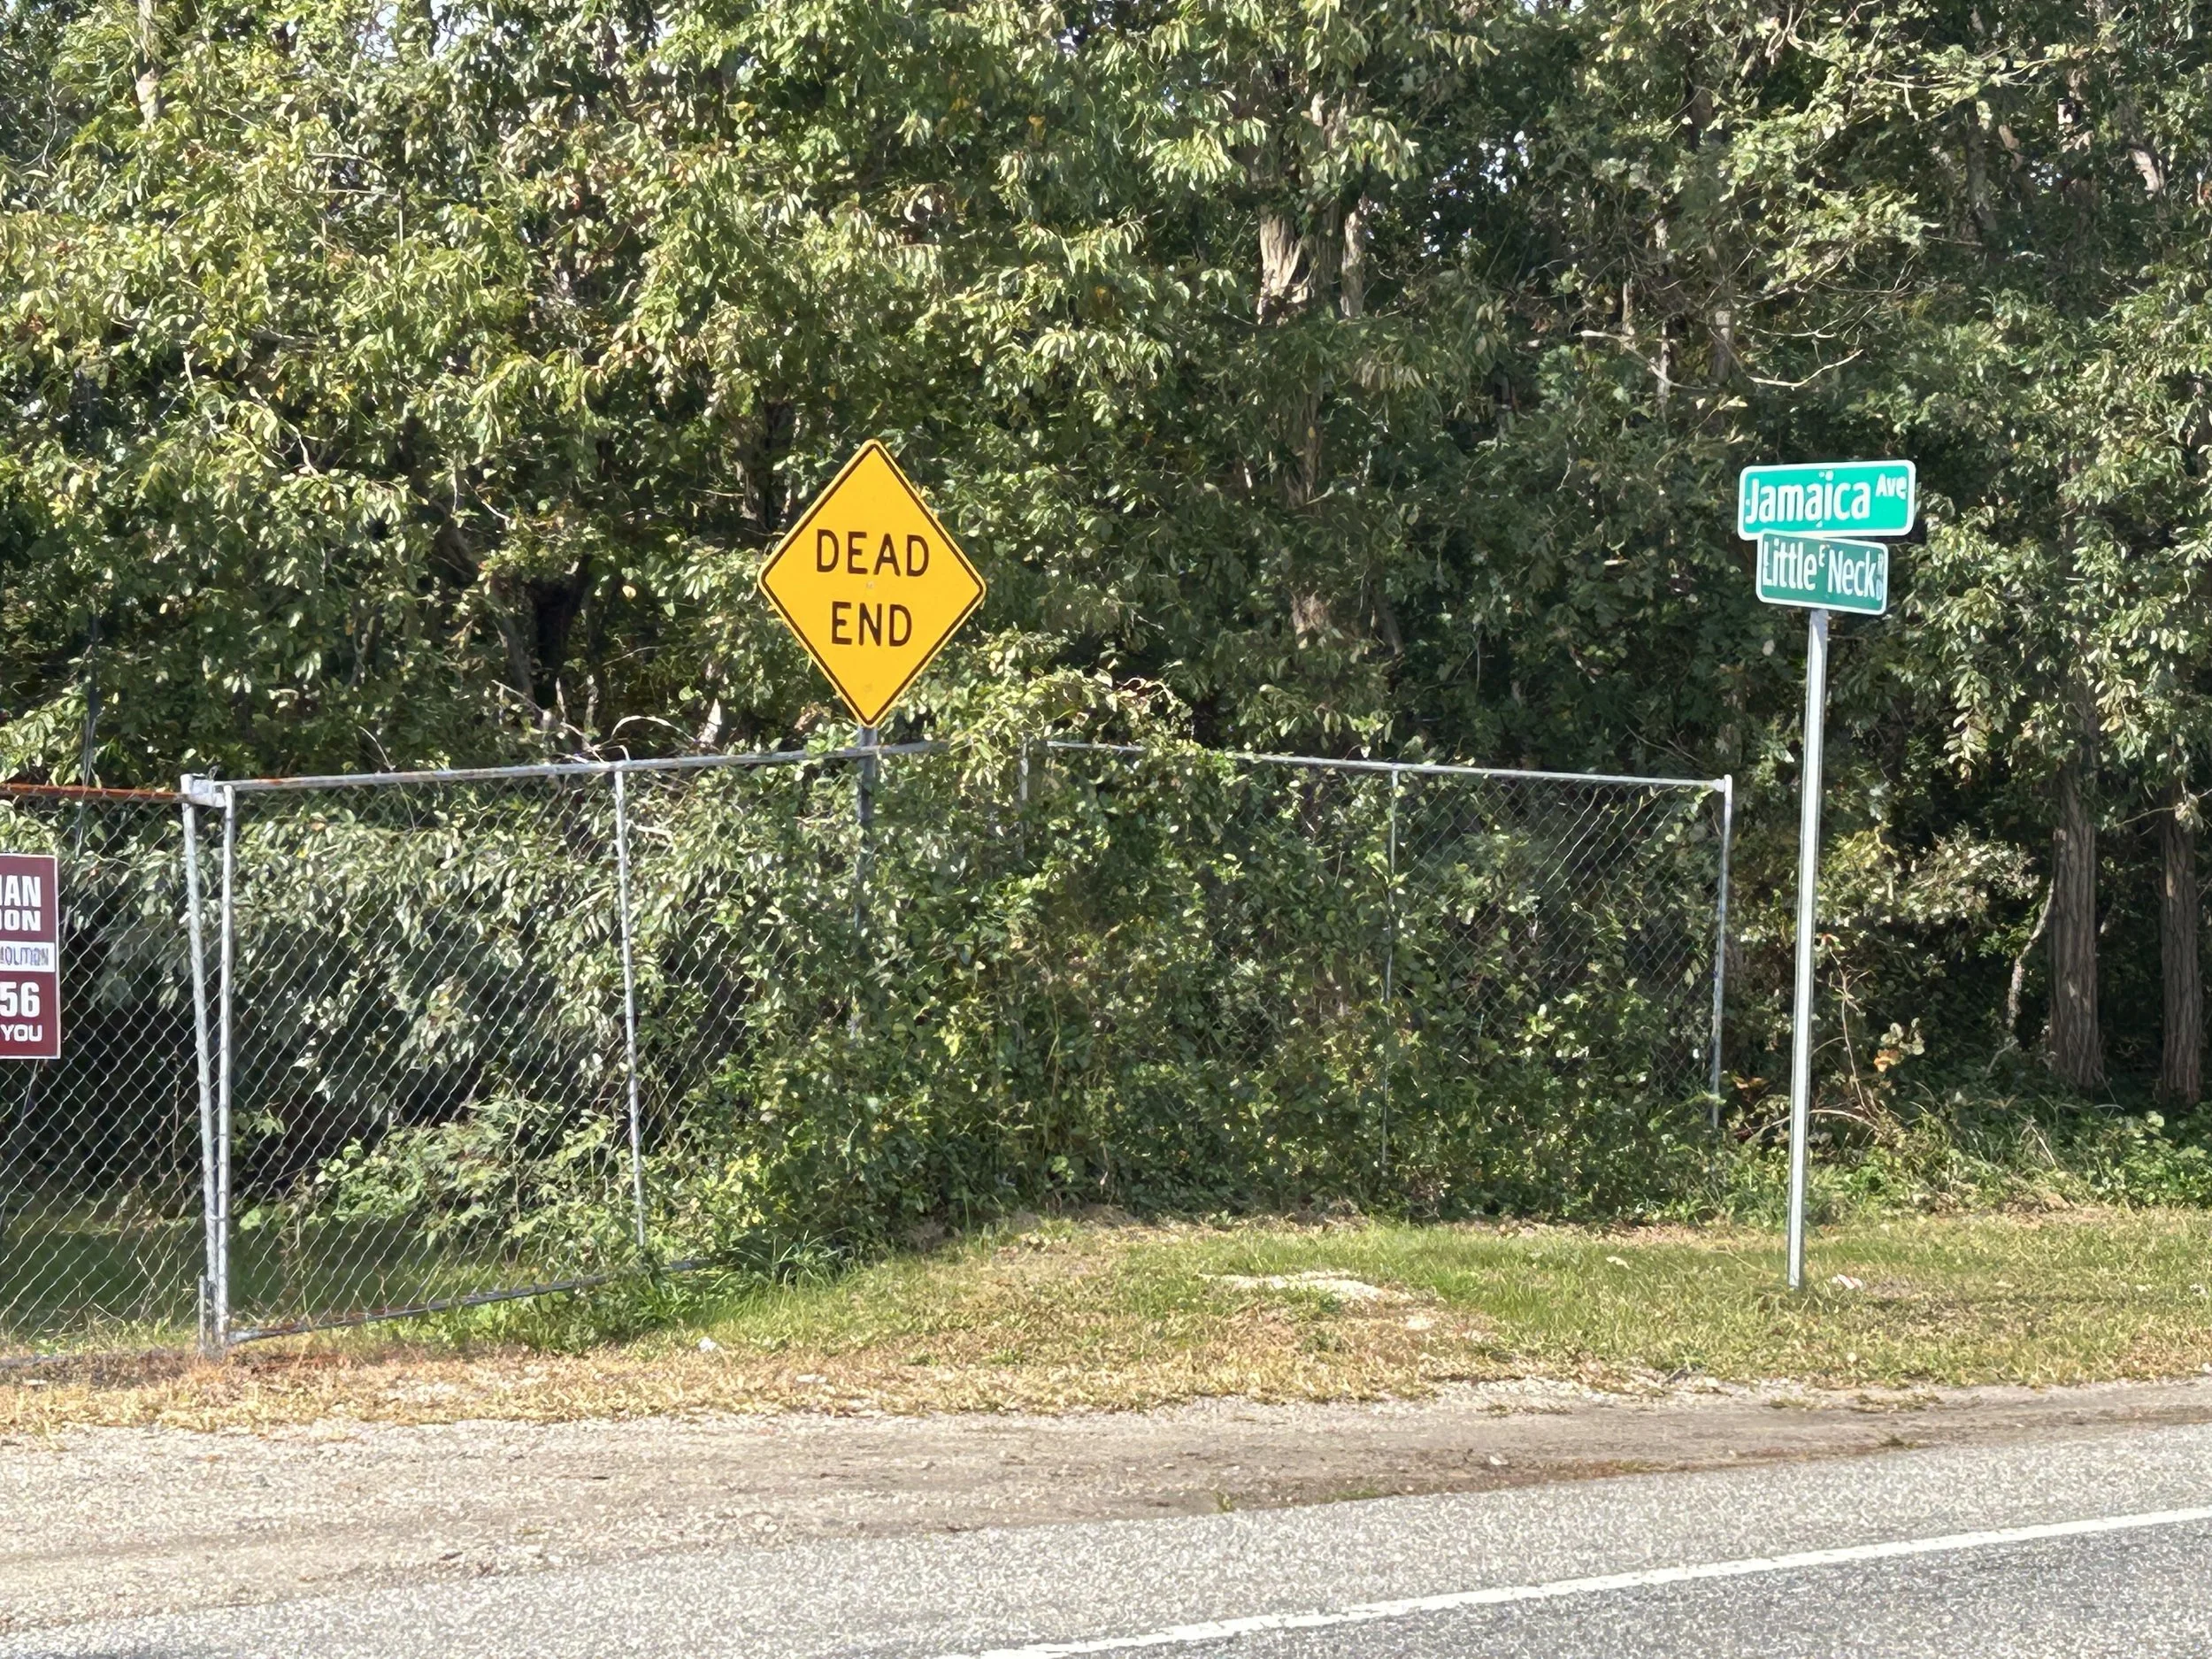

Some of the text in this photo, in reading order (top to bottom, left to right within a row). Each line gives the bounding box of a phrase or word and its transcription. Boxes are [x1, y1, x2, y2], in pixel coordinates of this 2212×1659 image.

[1745, 470, 1907, 524] Jamaica Ave
[816, 528, 930, 577] DEAD
[1763, 538, 1817, 591] Little
[1827, 549, 1876, 598] Neck
[831, 601, 912, 647] END
[0, 1024, 42, 1042] YOU
